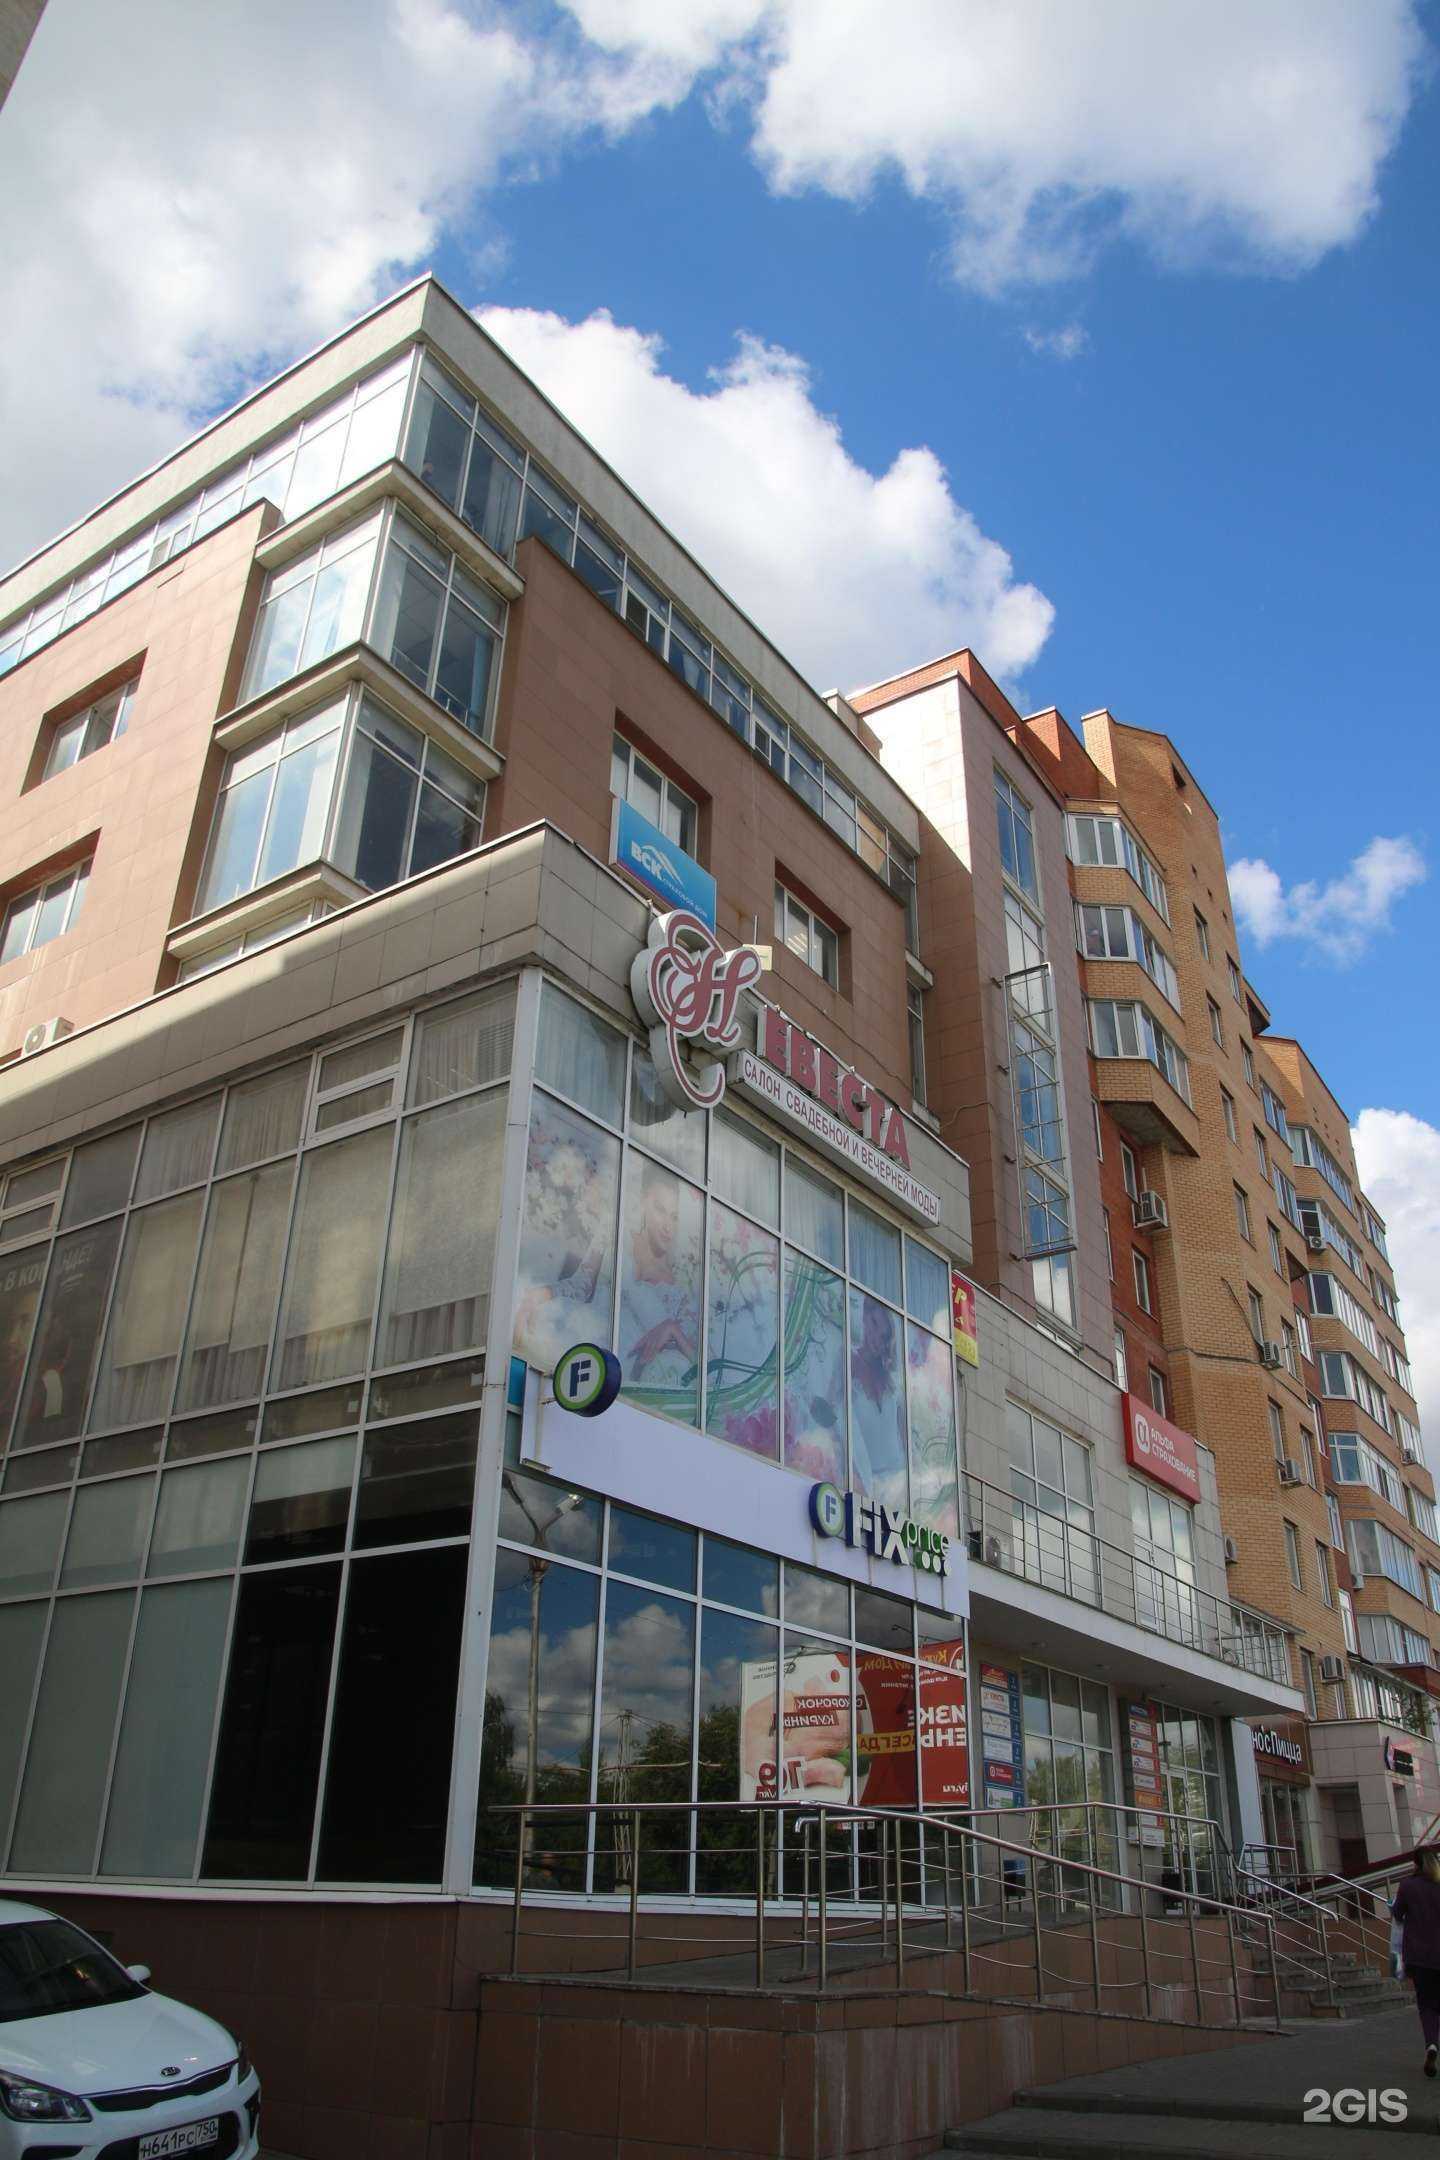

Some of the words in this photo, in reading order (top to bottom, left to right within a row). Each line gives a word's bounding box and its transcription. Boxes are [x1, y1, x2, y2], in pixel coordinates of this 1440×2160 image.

[631, 841, 662, 881] ВСК
[744, 1059, 781, 1101] САЛОН
[786, 1090, 850, 1151] СВАДЕБНОЙ
[852, 1138, 860, 1159] И
[861, 1146, 909, 1197] ВЕЧЕРНЕЙ
[911, 1184, 938, 1217] МОДЫ
[569, 1359, 592, 1398] F
[1151, 1428, 1175, 1453] АЛЬФА
[1152, 1443, 1197, 1482] СТРАХОВАНИЕ
